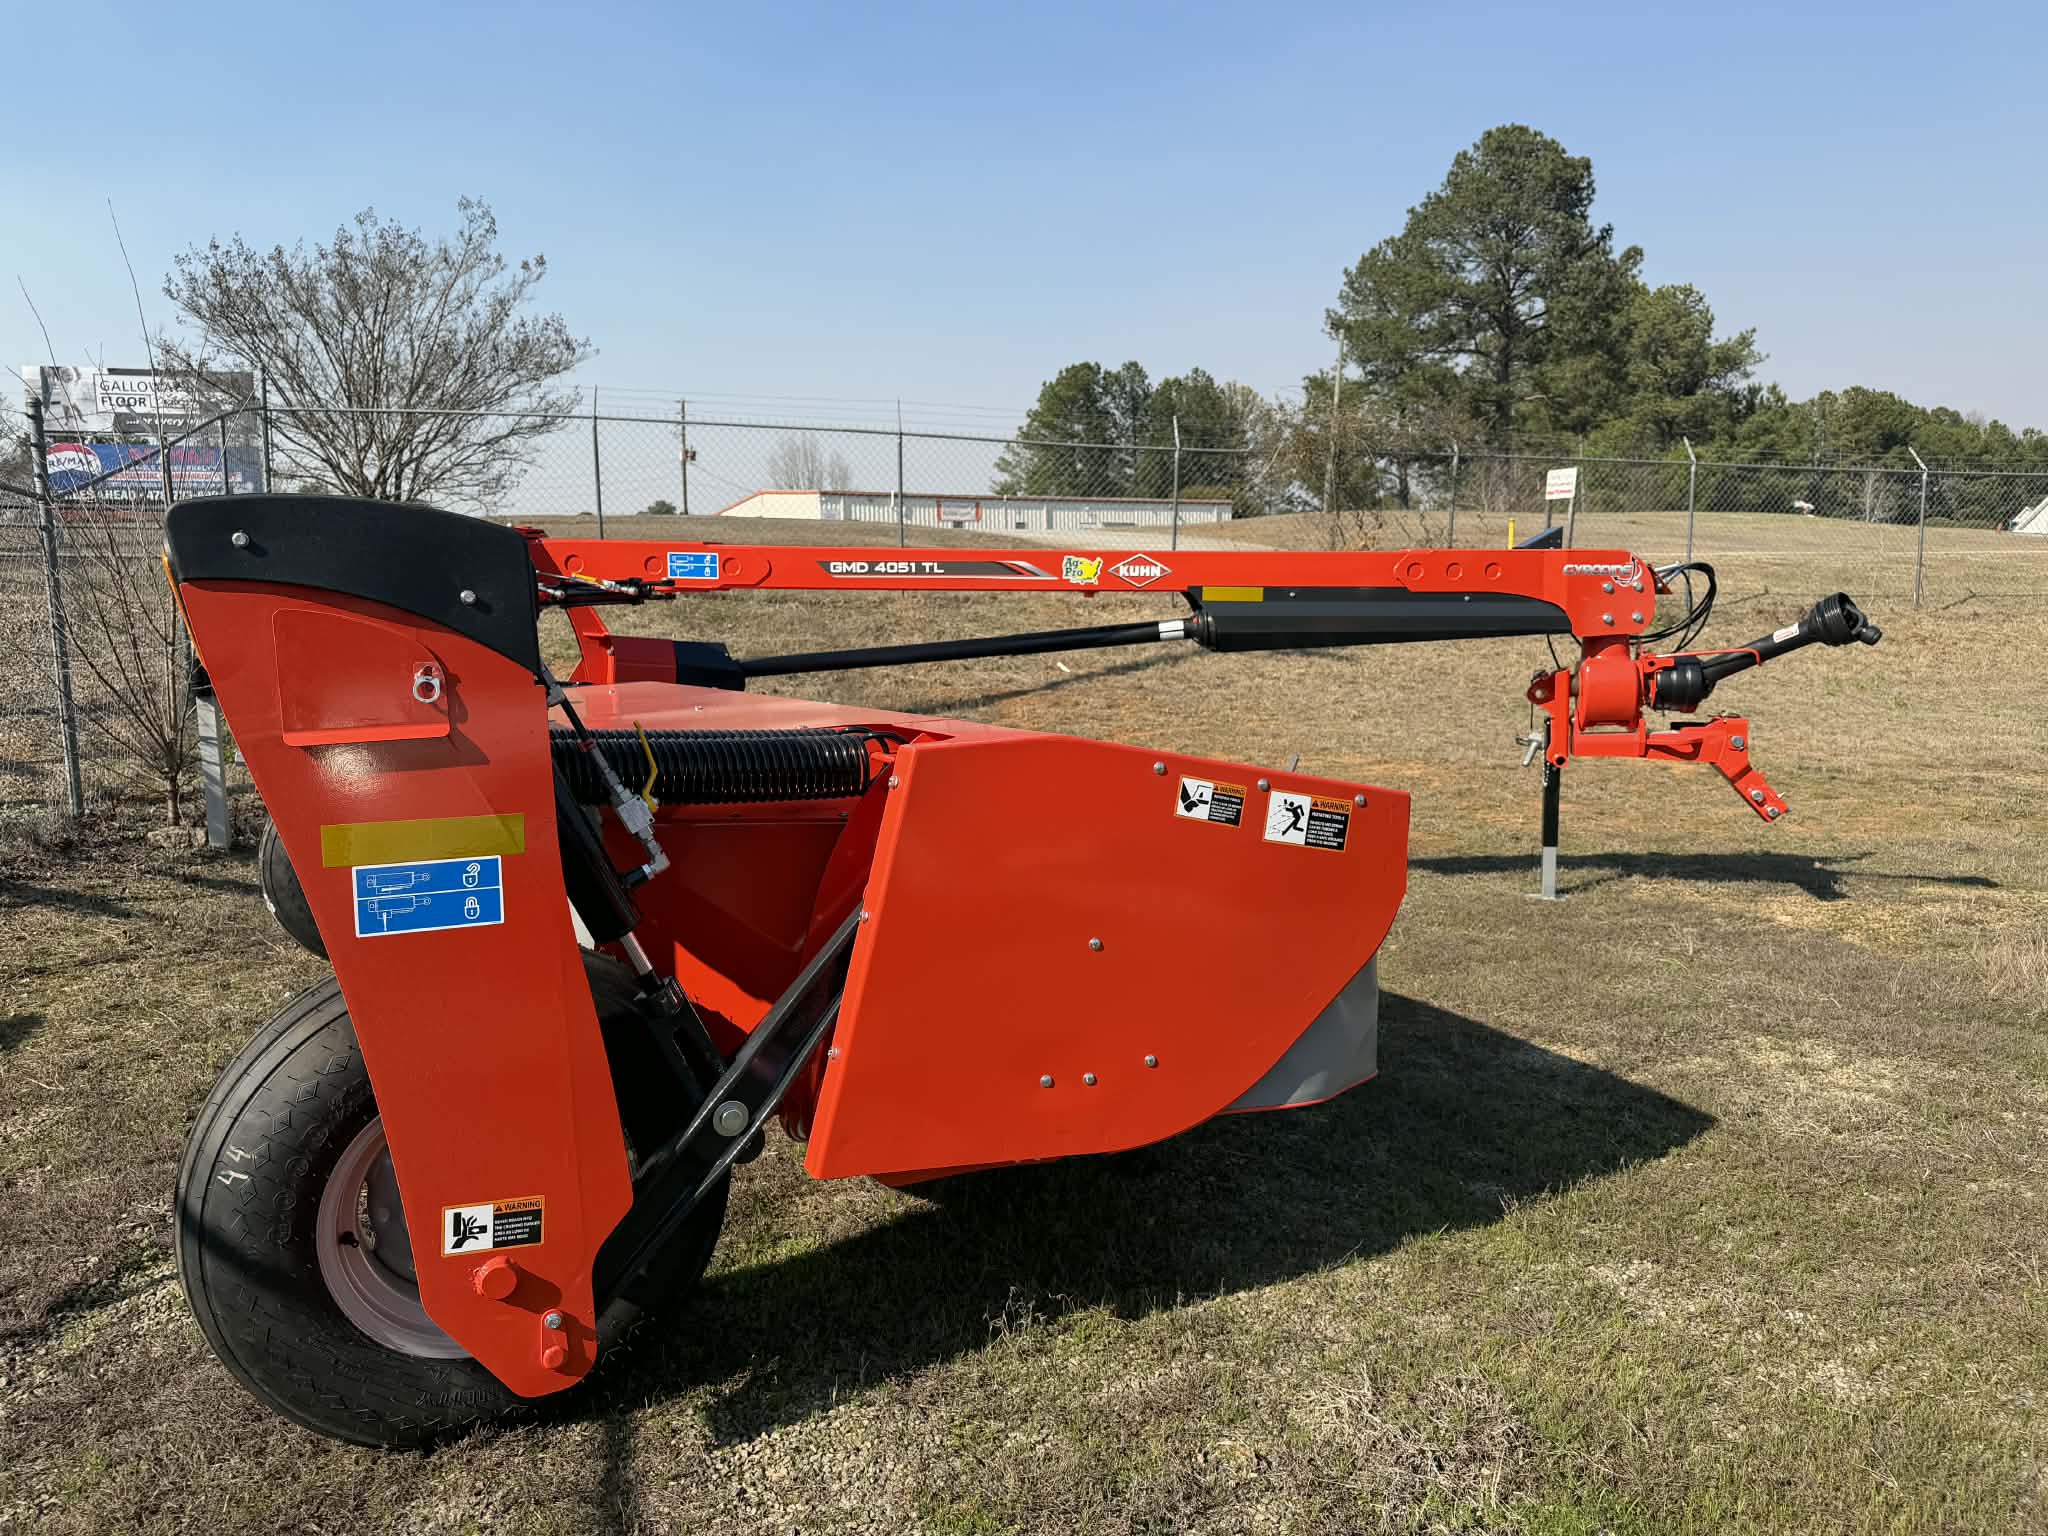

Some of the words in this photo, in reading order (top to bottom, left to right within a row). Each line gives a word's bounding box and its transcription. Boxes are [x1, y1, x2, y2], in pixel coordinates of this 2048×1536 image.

[101, 396, 147, 407] FLOOR
[97, 489, 136, 500] AHEAD
[829, 561, 868, 573] GMD
[874, 561, 916, 573] 4051
[921, 561, 945, 573] TL
[1064, 568, 1083, 577] Pro
[1119, 565, 1161, 577] KUHN
[1319, 800, 1350, 813] WARNING
[504, 1199, 541, 1211] WARNING
